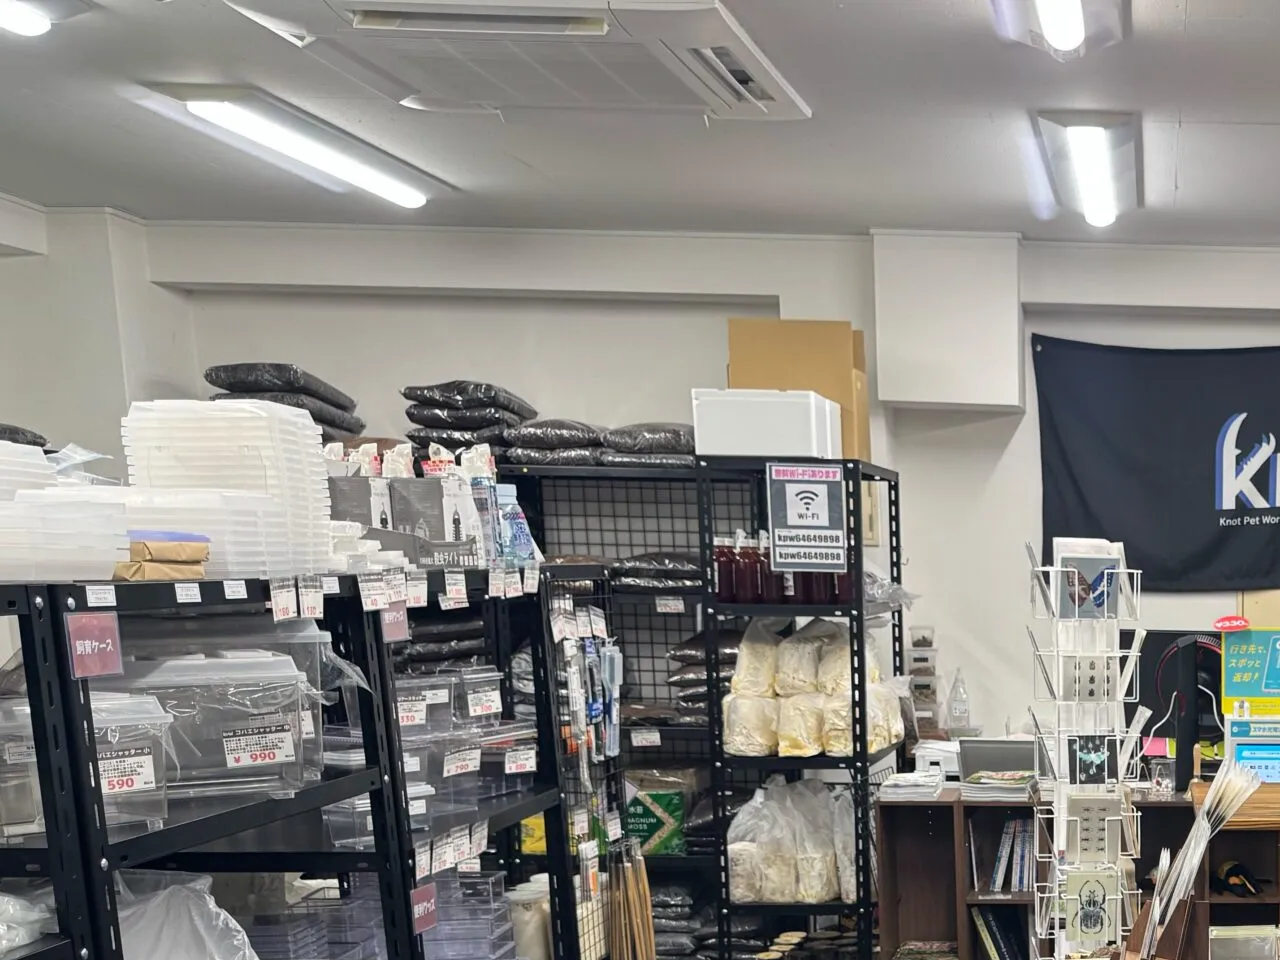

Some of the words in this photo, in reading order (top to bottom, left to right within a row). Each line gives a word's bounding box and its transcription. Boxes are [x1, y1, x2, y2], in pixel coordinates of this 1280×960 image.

[1220, 517, 1241, 526] Knot
[1244, 515, 1259, 525] Pet
[76, 639, 114, 655] 飼育ケース
[250, 751, 276, 763] 990
[108, 778, 134, 790] 590
